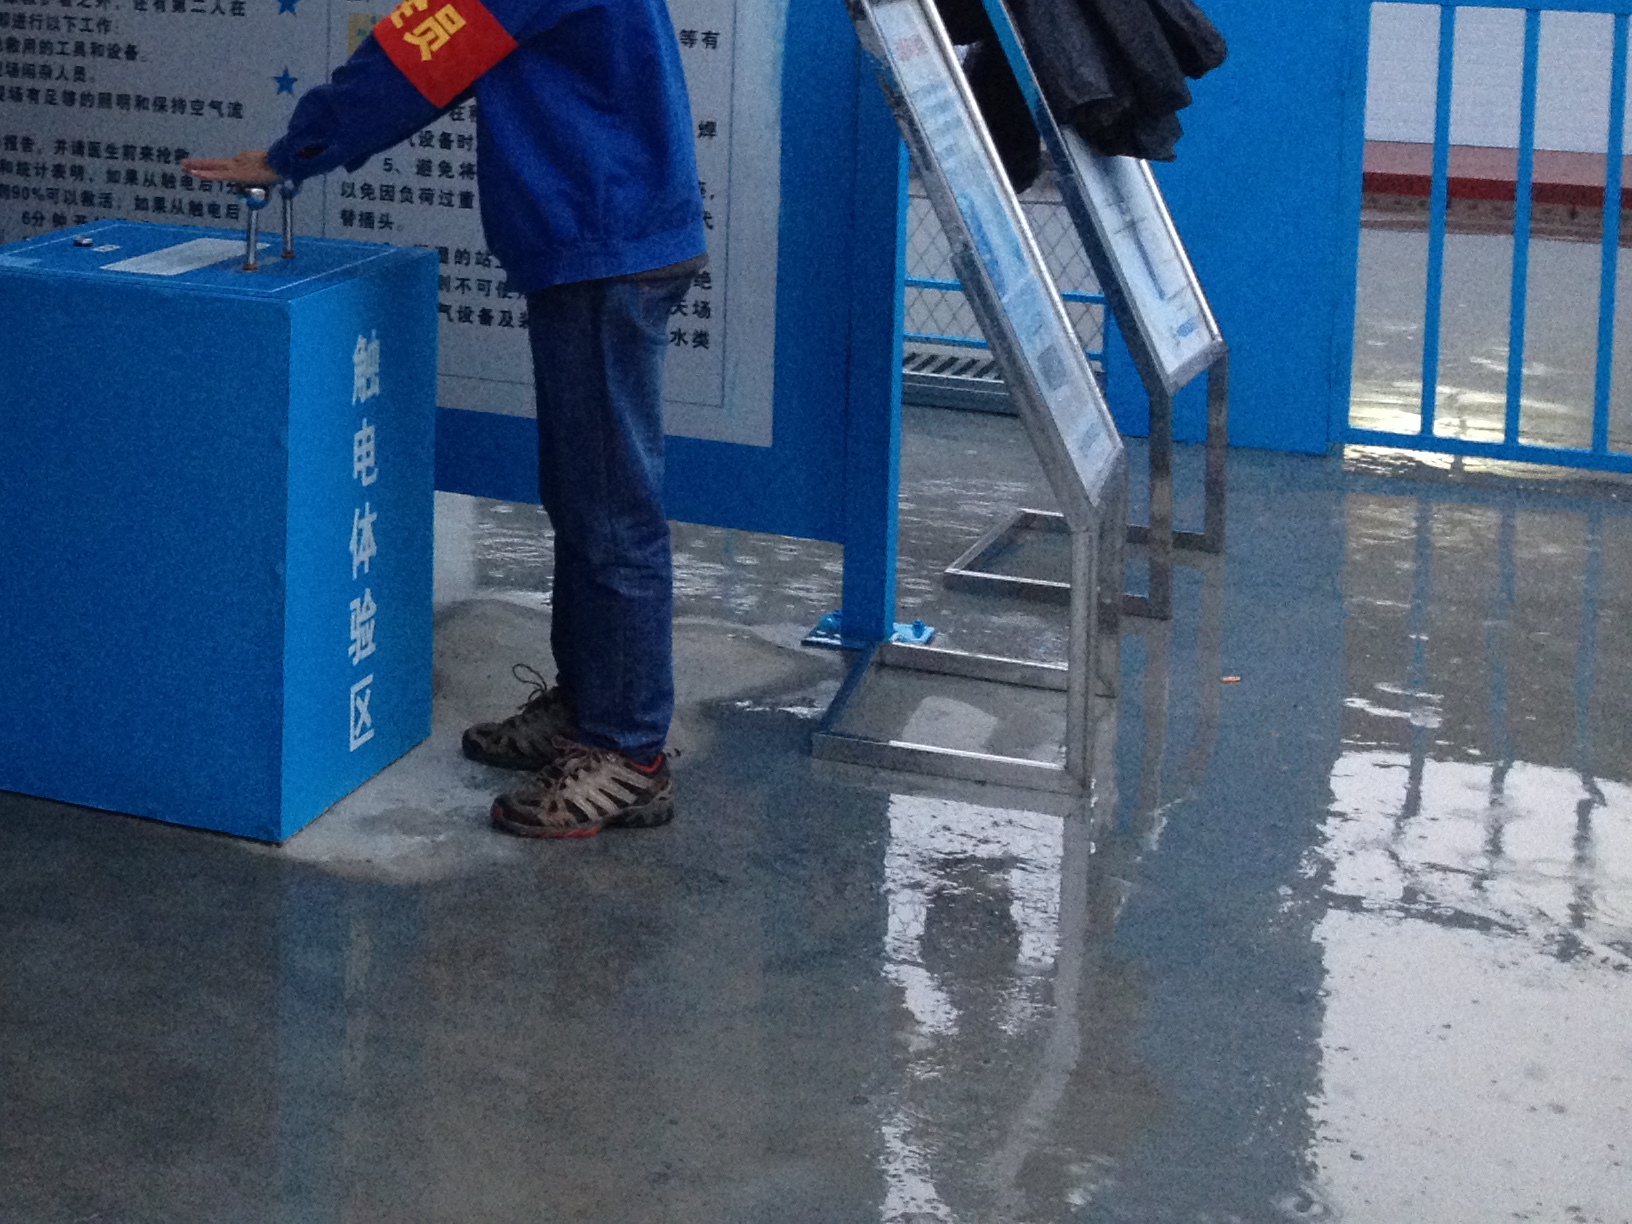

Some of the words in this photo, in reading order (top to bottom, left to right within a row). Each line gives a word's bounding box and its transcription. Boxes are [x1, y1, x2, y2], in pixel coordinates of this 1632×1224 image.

[347, 329, 381, 753] 触电体验区
